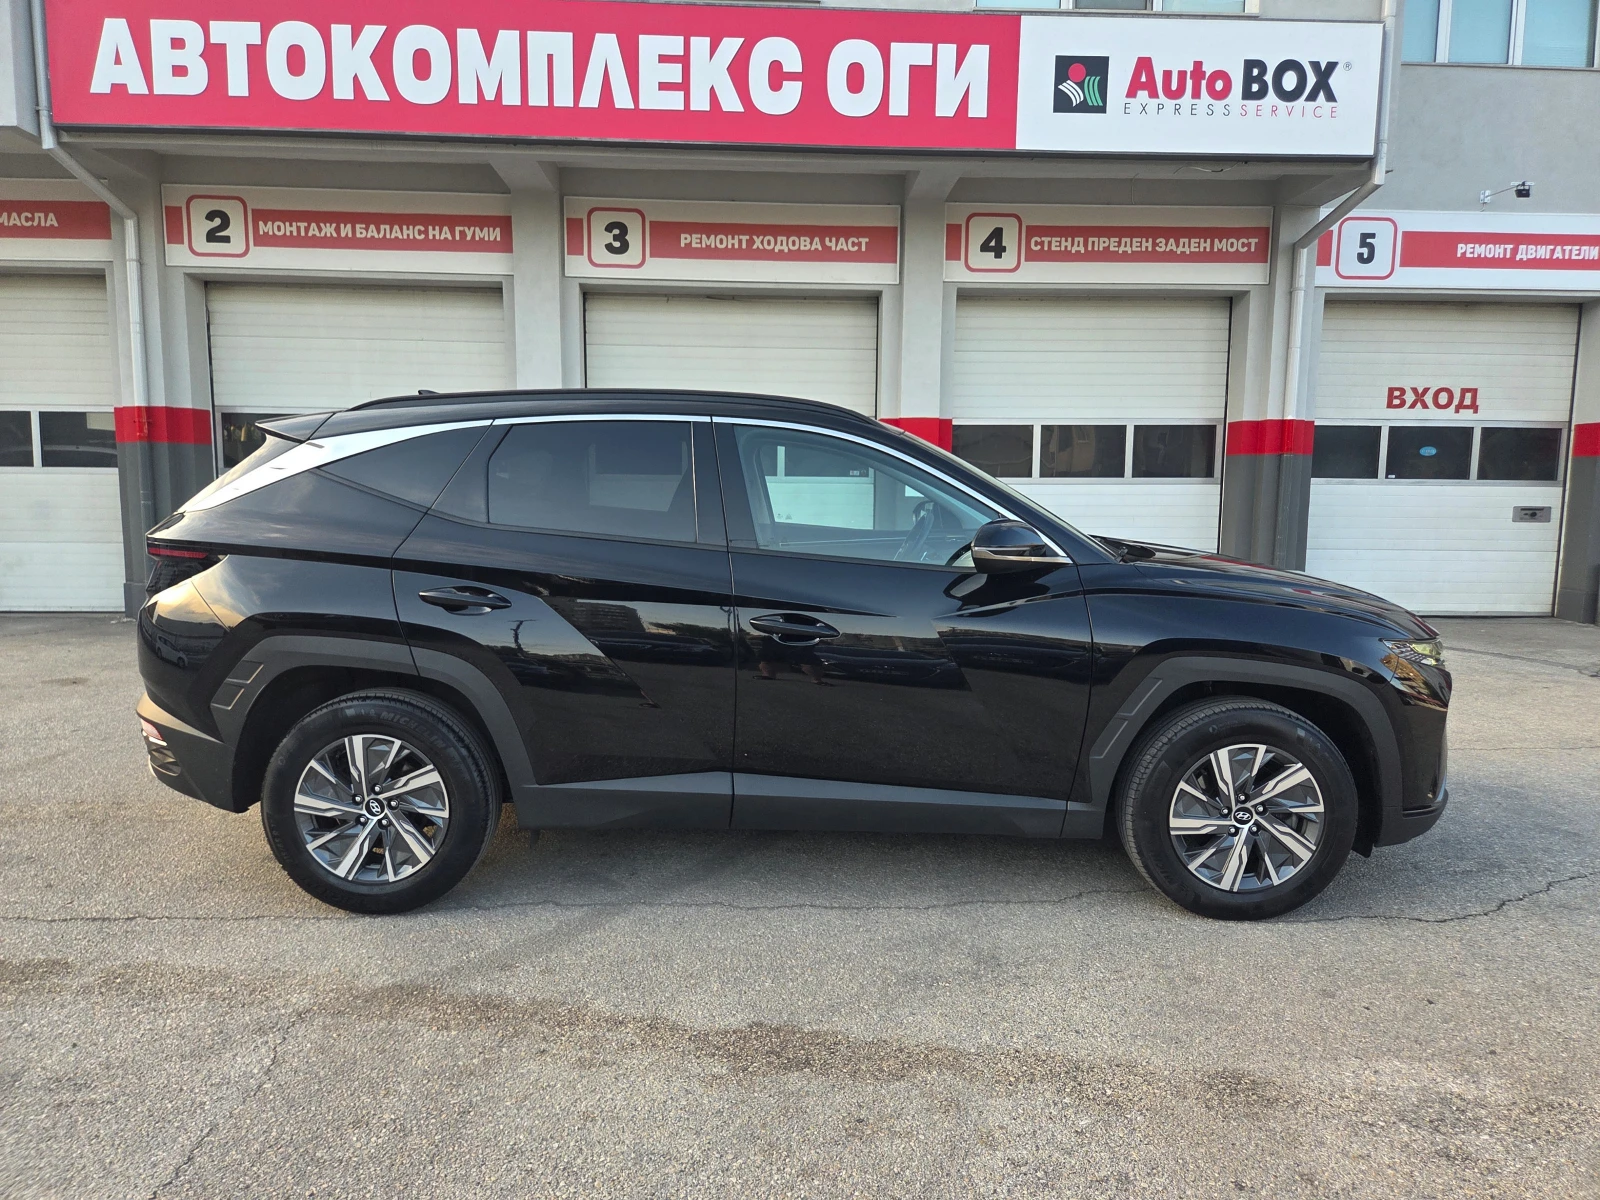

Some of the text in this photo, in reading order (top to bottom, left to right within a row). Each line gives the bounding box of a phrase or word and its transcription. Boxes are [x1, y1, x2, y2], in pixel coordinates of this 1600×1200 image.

[89, 17, 990, 119] АВТОКОМПЛЕКС ОГИ
[1125, 56, 1339, 103] Auto BOX
[205, 209, 231, 244] 2
[258, 220, 502, 242] МОНТАЖ И БАЛАНС НА ГУМИ
[604, 220, 630, 256] 3
[680, 233, 870, 253] РЕМОНТ ХОДОВА ЧАСТ
[979, 226, 1007, 260] 4
[1030, 236, 1259, 254] СТЕНД ПРЕДЕН ЗАДЕН МОСТ
[1356, 232, 1377, 265] 5
[1457, 243, 1599, 260] РЕМОНТ ДВИГАТЕЛИ
[1386, 387, 1479, 413] ВХОД
